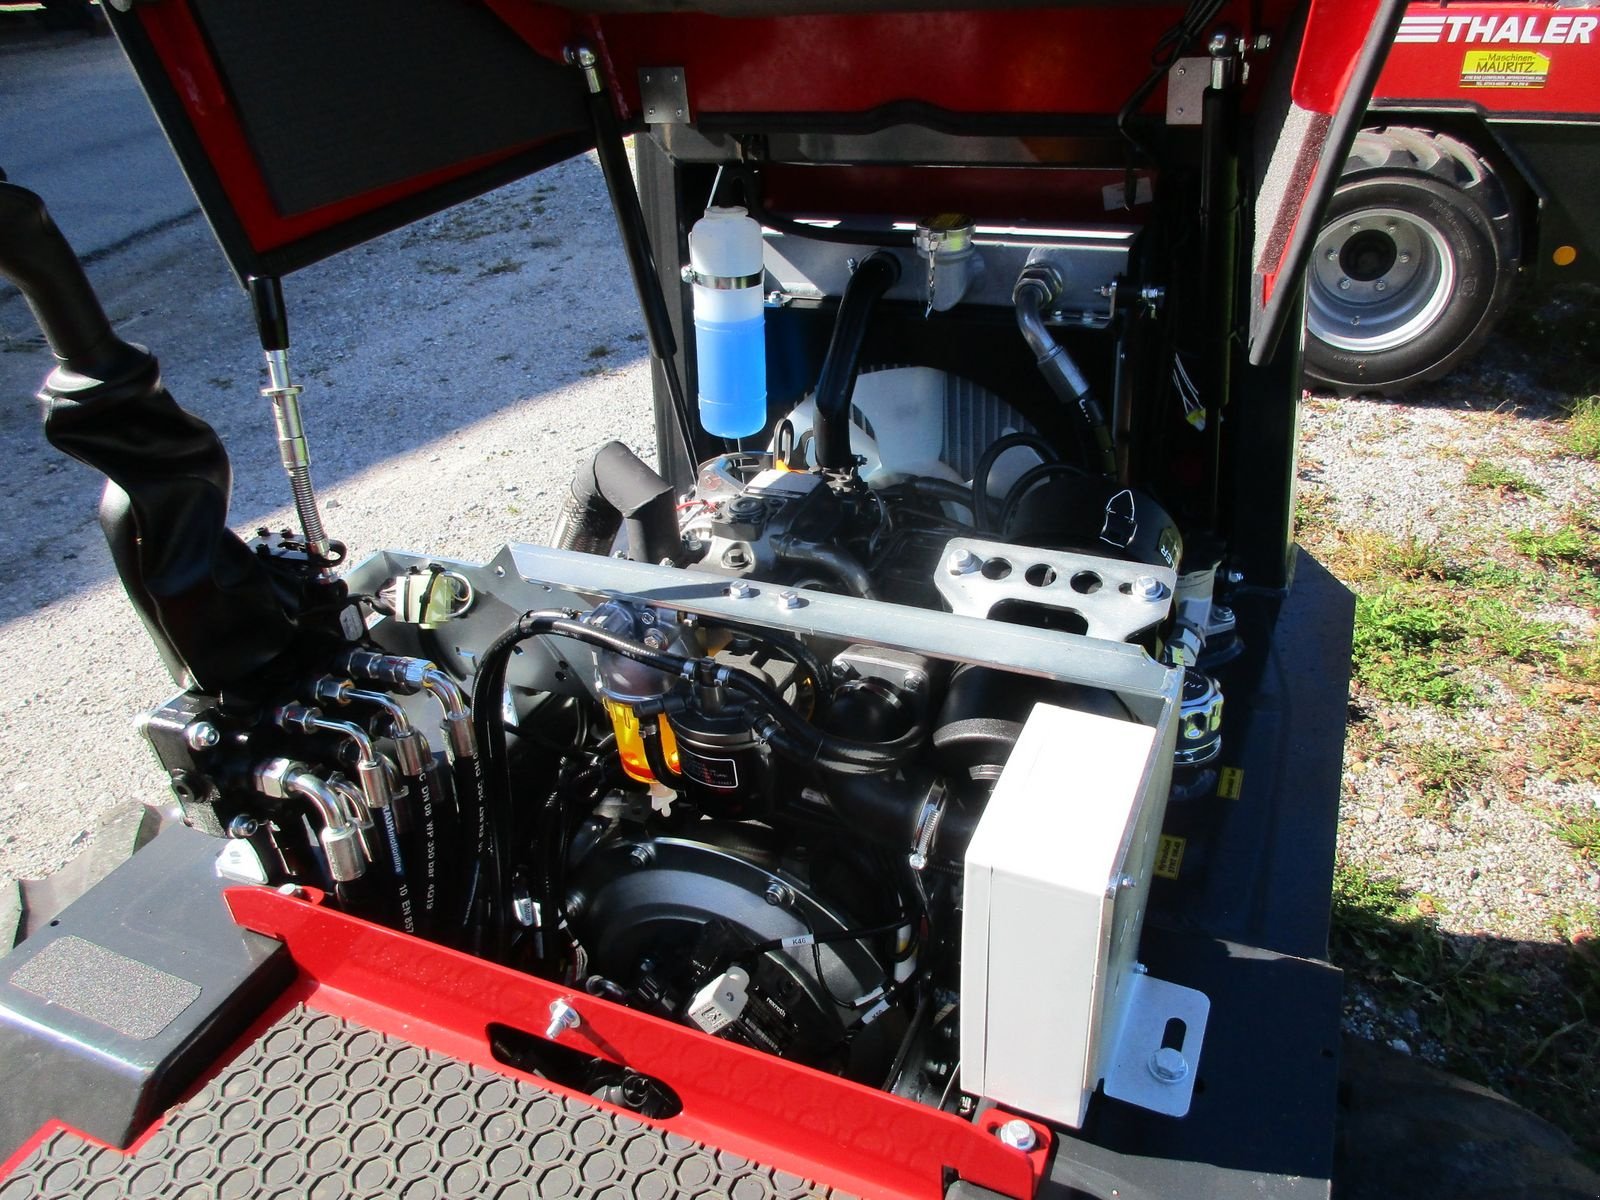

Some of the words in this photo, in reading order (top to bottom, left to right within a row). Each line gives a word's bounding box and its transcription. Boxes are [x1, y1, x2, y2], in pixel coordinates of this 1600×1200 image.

[1446, 16, 1598, 44] THALER
[1475, 61, 1535, 73] MAURITZ
[421, 785, 432, 802] DN
[427, 840, 435, 859] 350
[402, 899, 411, 916] EN
[404, 915, 414, 933] 857
[792, 937, 806, 945] K46
[766, 996, 786, 1018] rexroth
